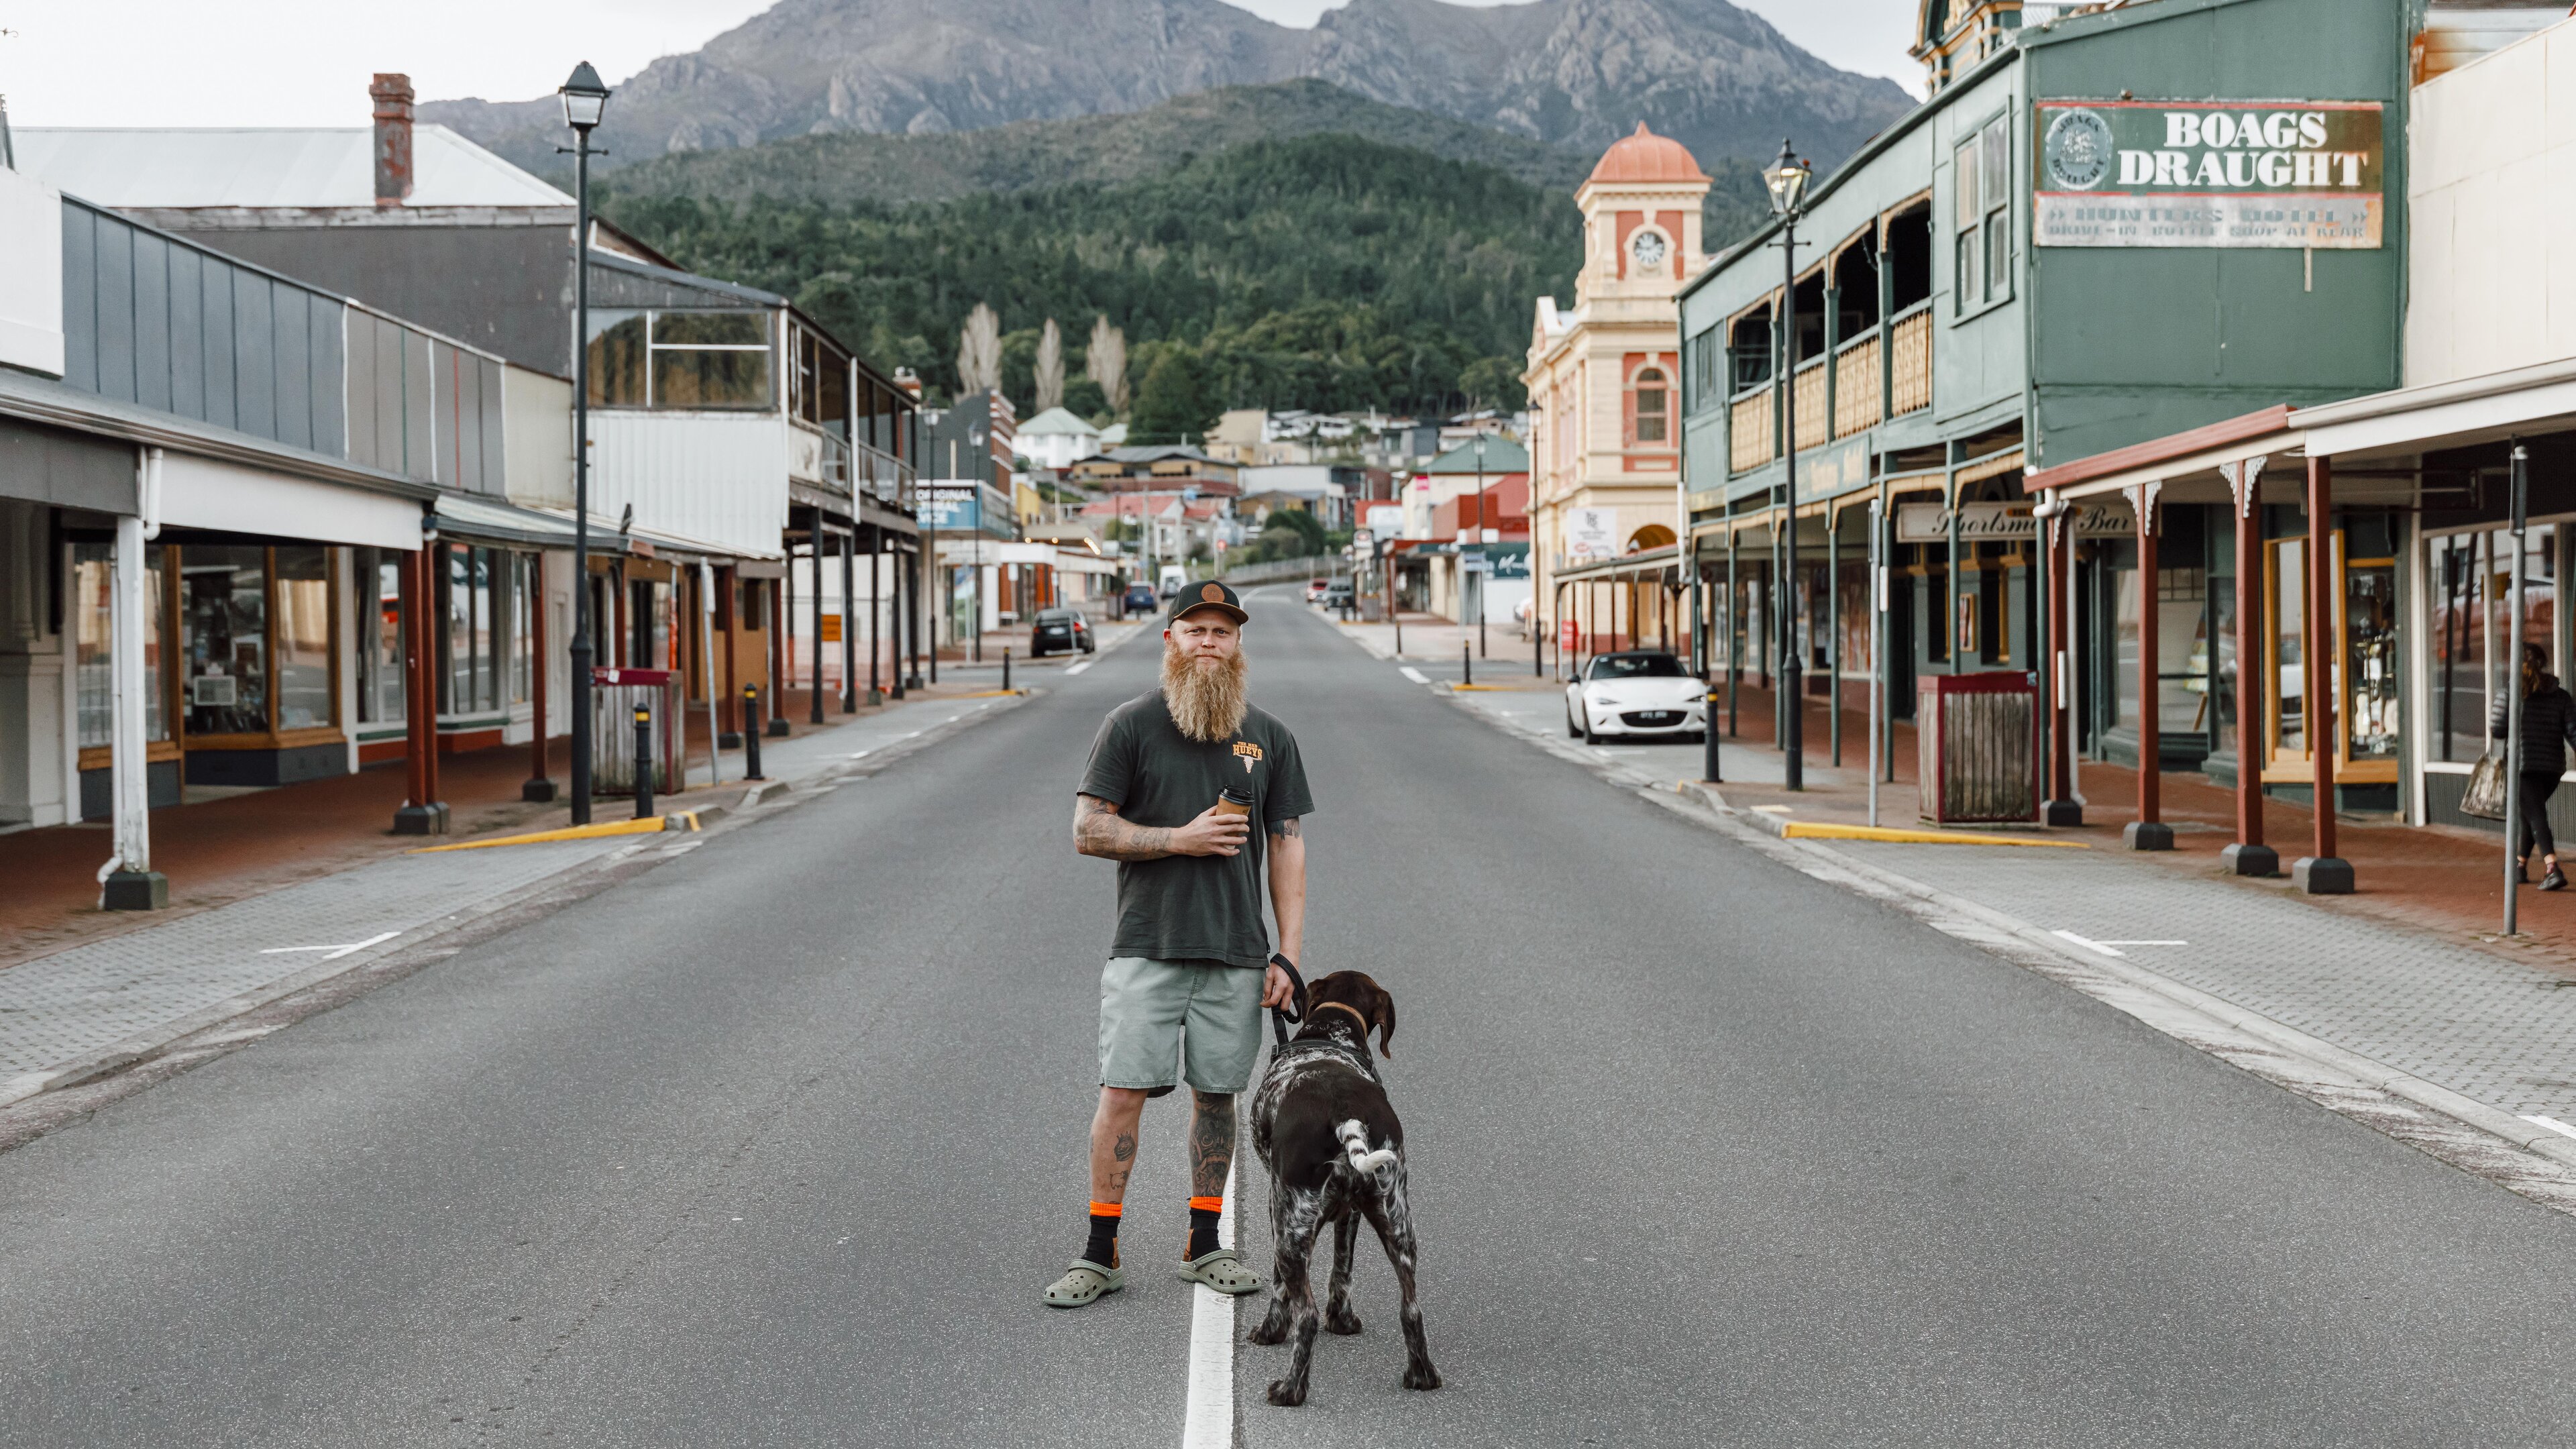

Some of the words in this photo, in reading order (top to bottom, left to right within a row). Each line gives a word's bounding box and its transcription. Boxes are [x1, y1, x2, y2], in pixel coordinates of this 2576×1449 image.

[2163, 111, 2328, 149] BOAGS
[2116, 150, 2369, 187] DRAUGHT
[2079, 506, 2129, 531] Bar
[1232, 744, 1263, 761] HUEYS
